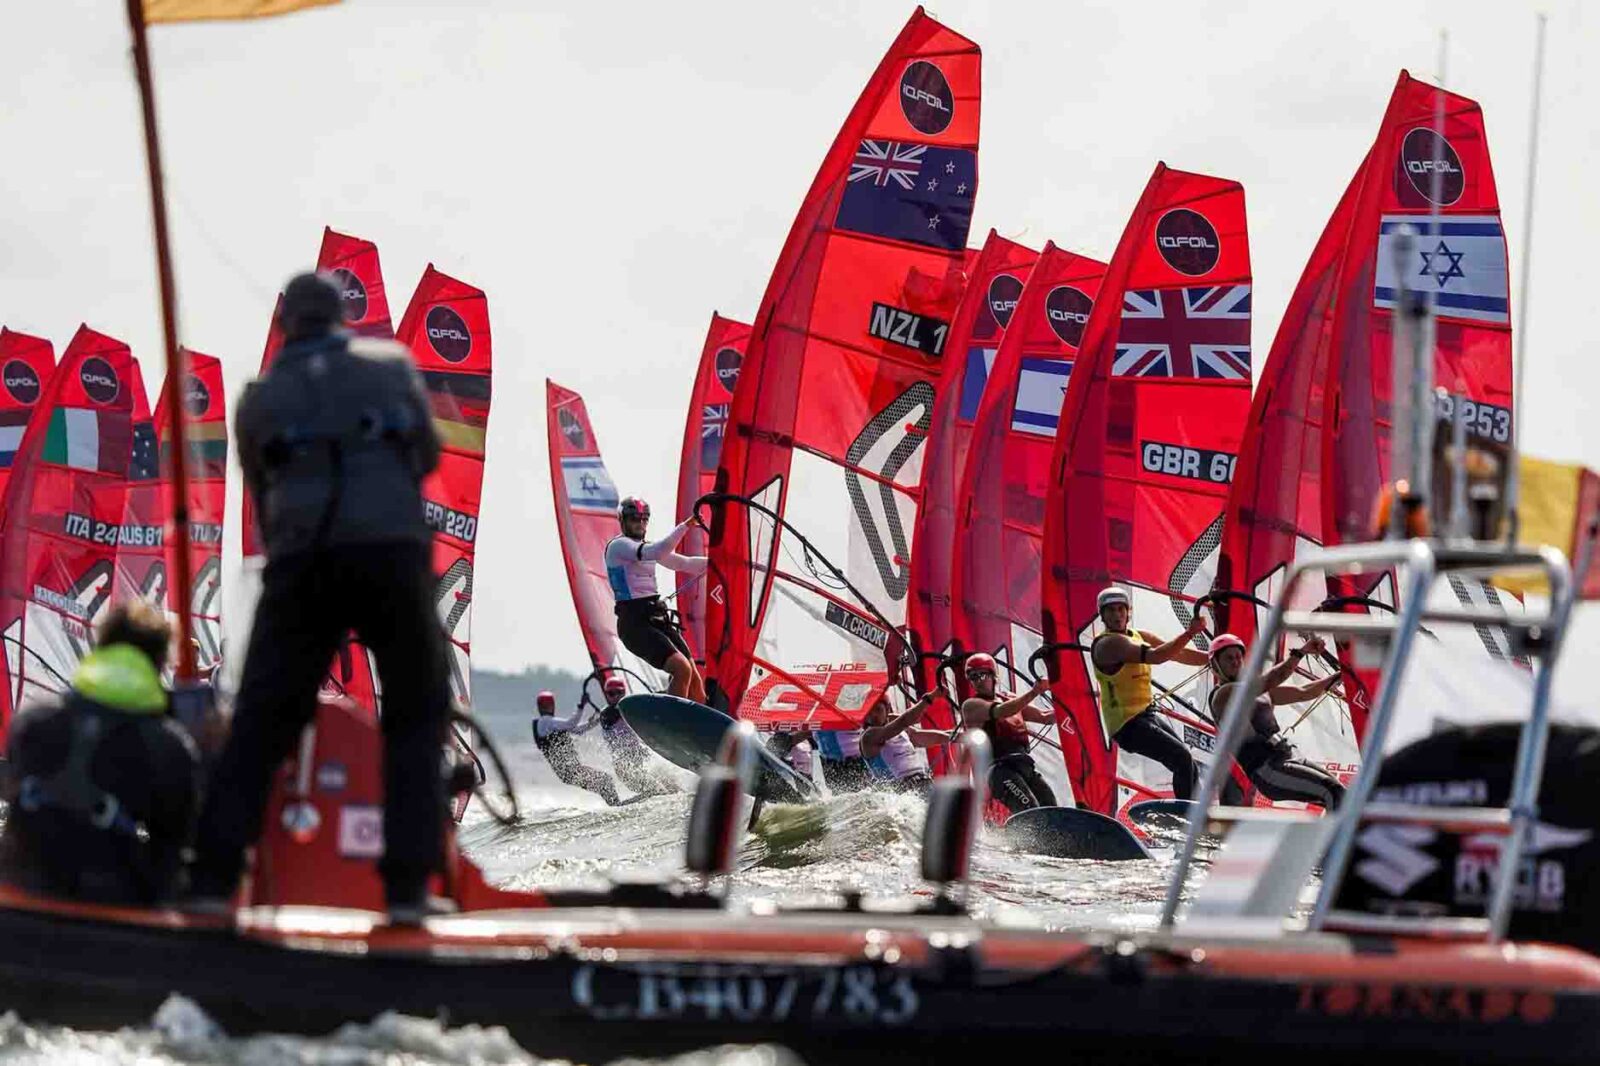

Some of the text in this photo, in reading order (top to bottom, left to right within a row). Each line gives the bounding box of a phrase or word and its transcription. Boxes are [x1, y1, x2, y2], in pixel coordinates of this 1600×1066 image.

[870, 305, 948, 354] NZL 1
[1461, 402, 1510, 442] 253
[1143, 443, 1200, 478] GBR
[66, 514, 118, 545] ITA 24
[118, 525, 163, 546] AUS 81
[424, 502, 476, 541] ER 220
[849, 614, 884, 648] CROOK
